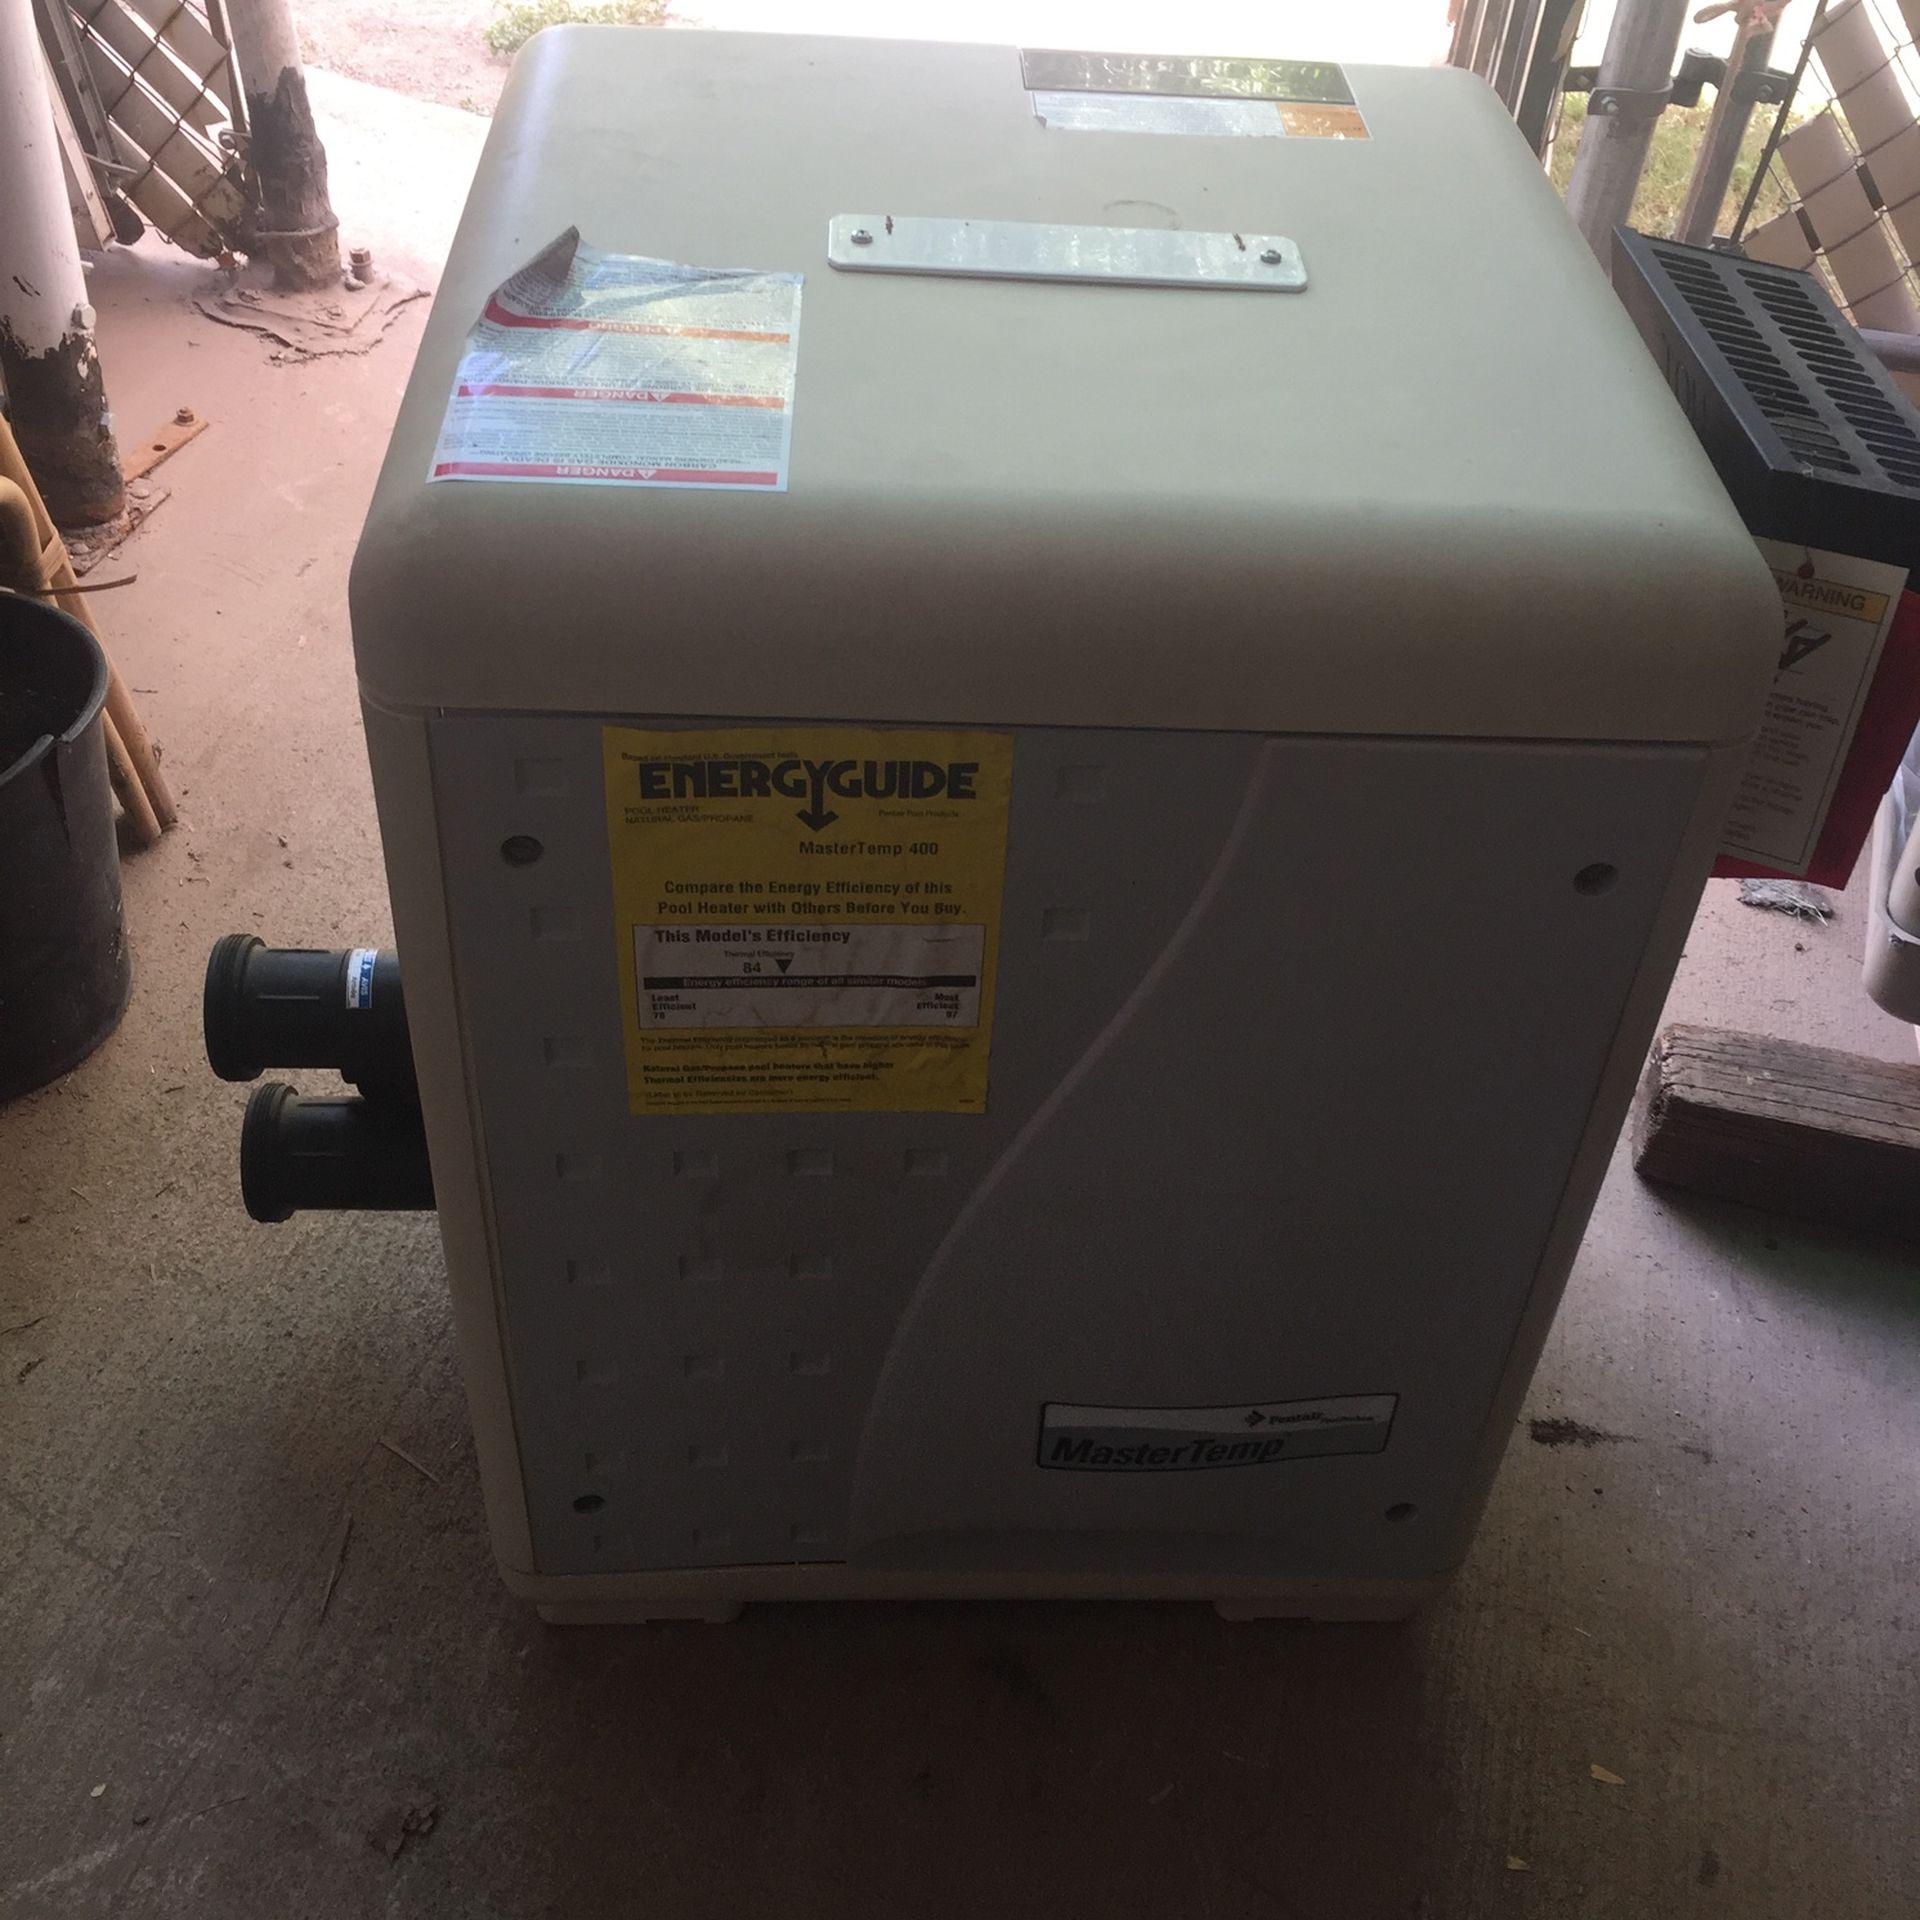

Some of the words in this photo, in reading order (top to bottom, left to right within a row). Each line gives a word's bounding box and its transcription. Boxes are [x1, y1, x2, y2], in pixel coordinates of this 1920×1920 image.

[574, 390, 648, 400] DANGER
[502, 455, 551, 464] DEADLY
[568, 457, 594, 465] GAS
[598, 459, 663, 468] MONOXIDE
[666, 461, 718, 469] CARBON
[557, 466, 636, 478] DANGER
[639, 759, 980, 801] ENERGYGUIDE
[625, 806, 654, 815] POOL
[656, 805, 700, 814] HEATER
[625, 815, 676, 824] NATURAL
[677, 814, 753, 824] GAS/PROPANE
[799, 841, 903, 857] MasterTemp
[909, 842, 939, 855] 400
[664, 881, 734, 896] Compare
[739, 881, 764, 893] the
[769, 881, 821, 896] Energy
[826, 881, 900, 896] Efficiency
[905, 881, 920, 893] of
[924, 881, 953, 893] this
[658, 901, 692, 914] Pool
[698, 901, 749, 914] Heater
[753, 902, 786, 914] with
[791, 902, 841, 914] Others
[846, 902, 895, 914] Before
[900, 902, 929, 914] You
[934, 902, 967, 915] Buy.
[655, 929, 691, 943] This
[696, 928, 762, 943] Model's
[767, 929, 851, 944] Efficiency
[724, 950, 756, 958] Thermal
[758, 950, 795, 958] Efficiency
[743, 962, 761, 974] 84
[683, 978, 722, 988] Energy
[725, 978, 779, 988] efficiency
[782, 978, 814, 988] range
[818, 976, 829, 985] of
[831, 976, 845, 985] all
[847, 976, 883, 985] similar
[887, 977, 927, 986] models
[652, 994, 680, 1002] Least
[935, 993, 960, 1001] Most
[652, 1003, 697, 1011] Efficient
[917, 1002, 960, 1010] Efficient
[643, 1065, 681, 1073] Natural
[748, 1063, 771, 1071] pool
[773, 1062, 811, 1070] heaters
[813, 1062, 834, 1070] that
[837, 1062, 861, 1070] have
[863, 1062, 894, 1070] higher
[688, 1076, 748, 1084] Efficiencies
[796, 1075, 830, 1083] energy
[833, 1073, 879, 1082] efficient.
[1267, 1412, 1323, 1425] Pentair
[1050, 1436, 1285, 1465] MasterTemp
